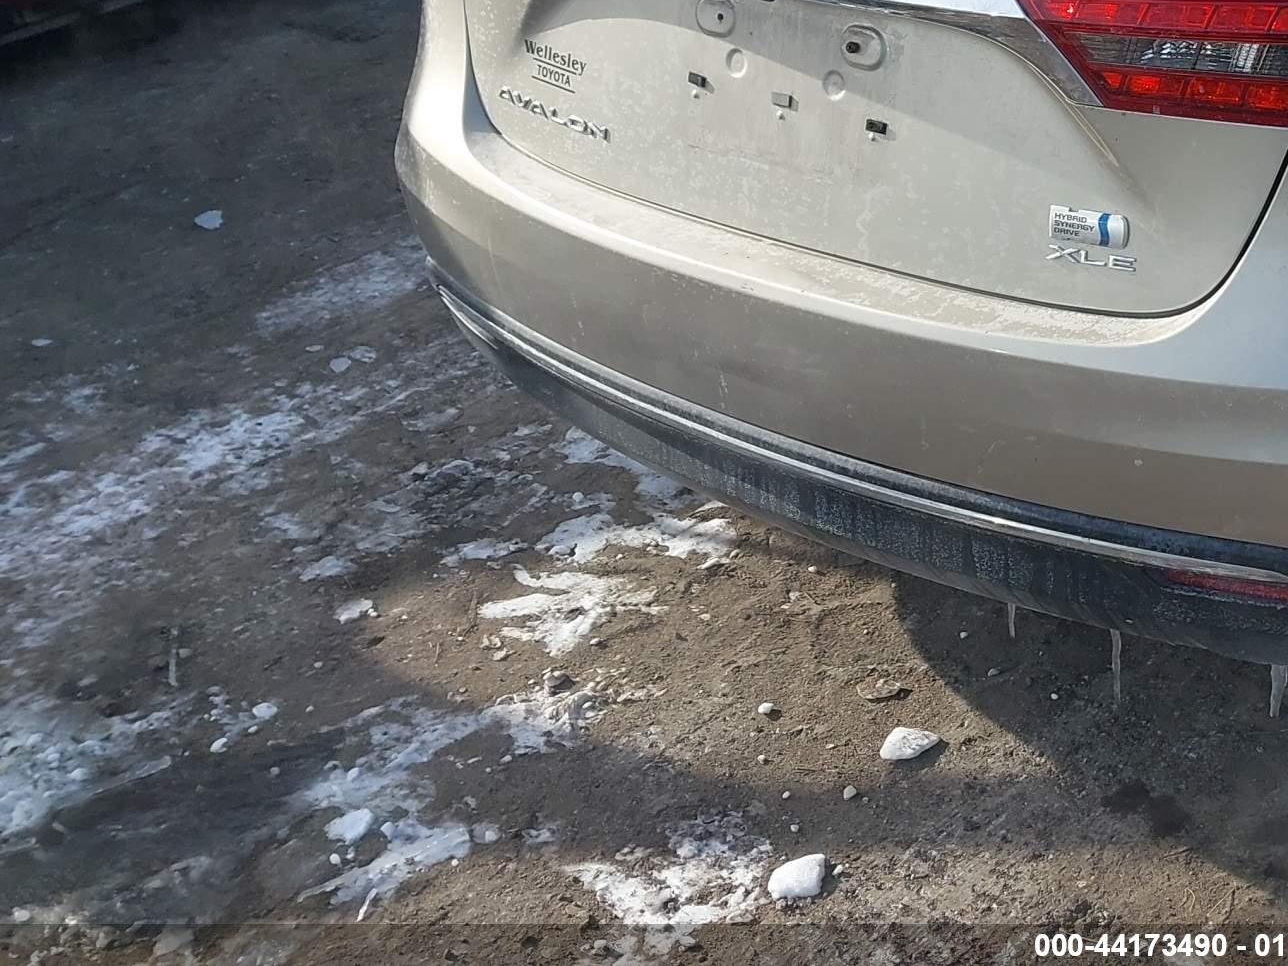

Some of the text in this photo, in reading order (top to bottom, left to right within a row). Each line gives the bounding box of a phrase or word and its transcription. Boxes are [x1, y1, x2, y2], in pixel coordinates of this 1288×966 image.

[524, 39, 587, 76] Wellesley
[537, 64, 571, 87] TOYOTA
[498, 86, 611, 144] AVALON
[1054, 212, 1087, 223] HYBRID
[1054, 220, 1095, 232] SYNERGY
[1054, 227, 1080, 237] DRIVE
[1044, 244, 1137, 272] XLE
